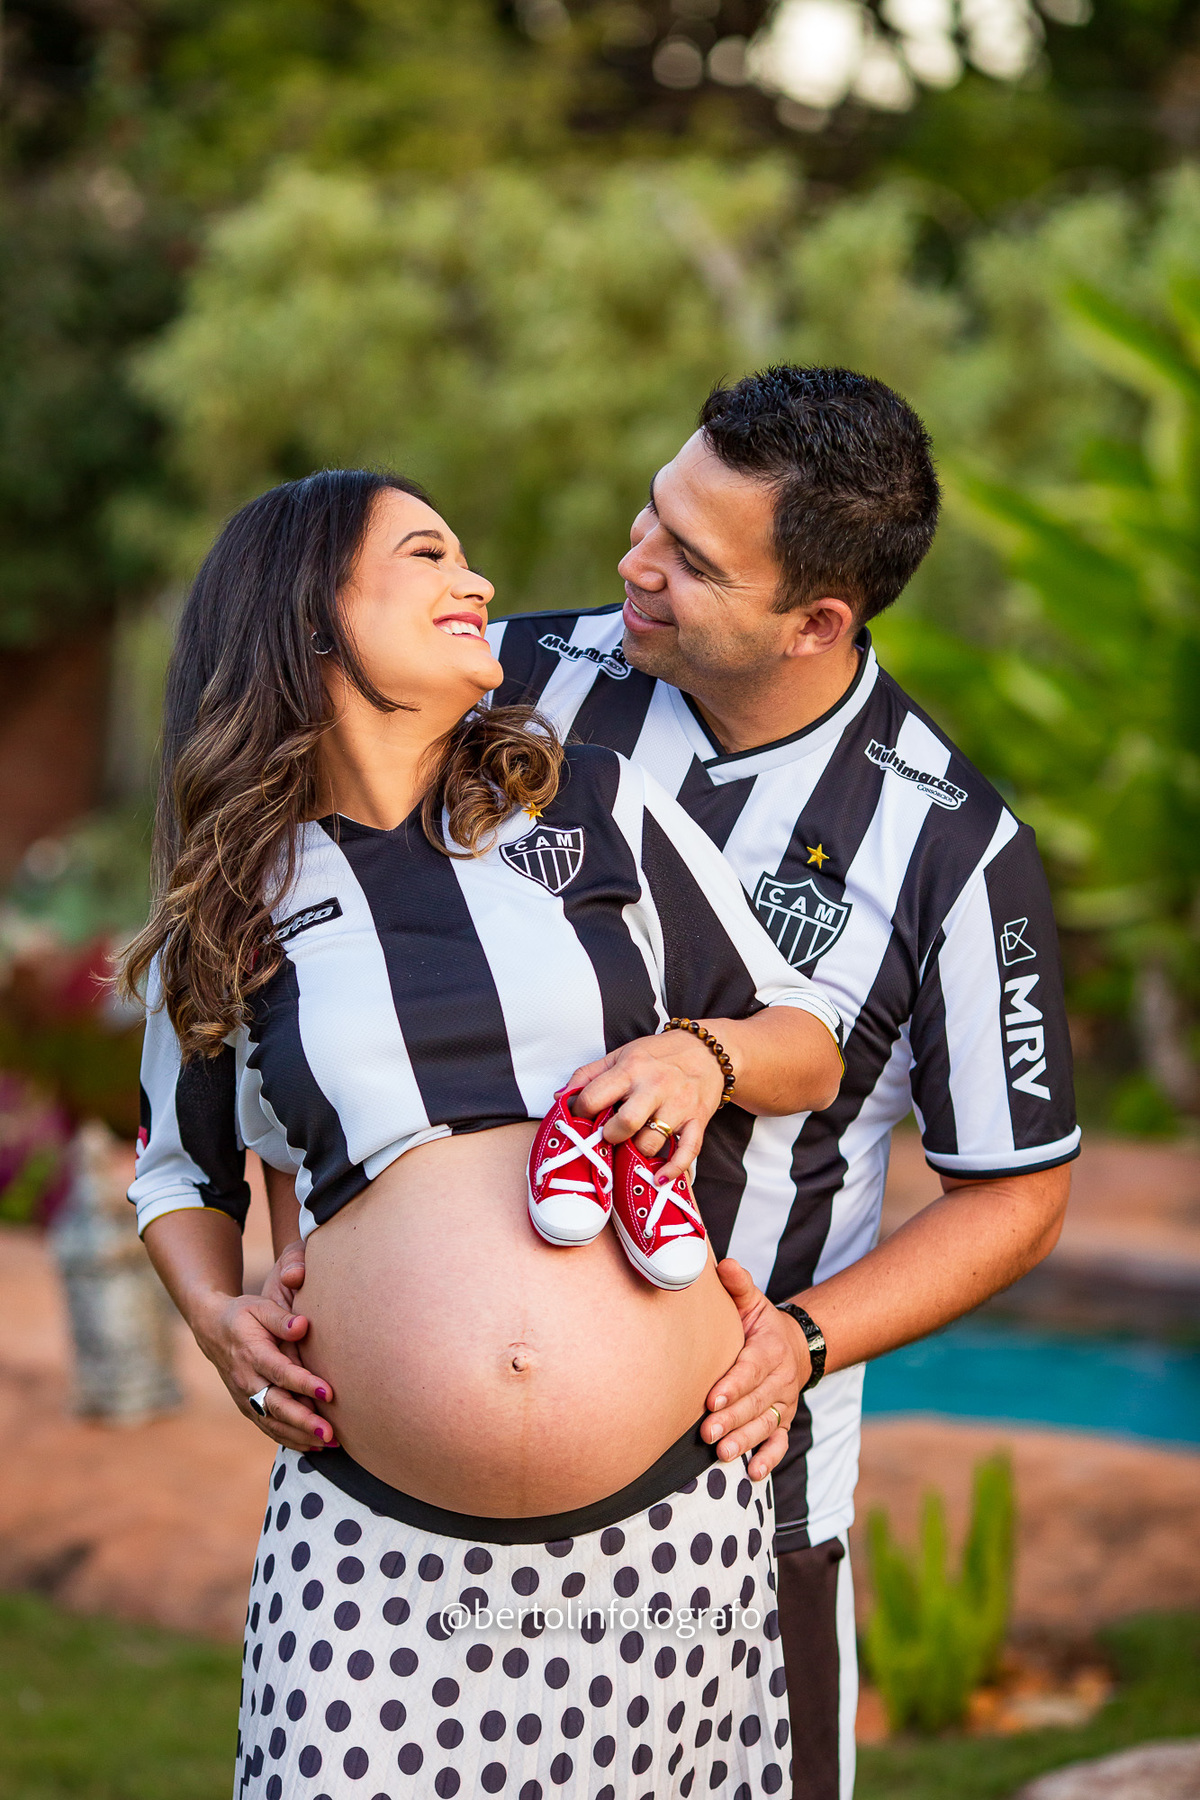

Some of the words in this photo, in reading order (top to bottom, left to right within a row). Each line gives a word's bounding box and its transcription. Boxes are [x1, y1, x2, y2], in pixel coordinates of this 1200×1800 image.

[867, 741, 967, 801] Multimarcas
[514, 833, 574, 851] CAM
[768, 888, 837, 925] CAM
[1004, 973, 1051, 1101] MRV
